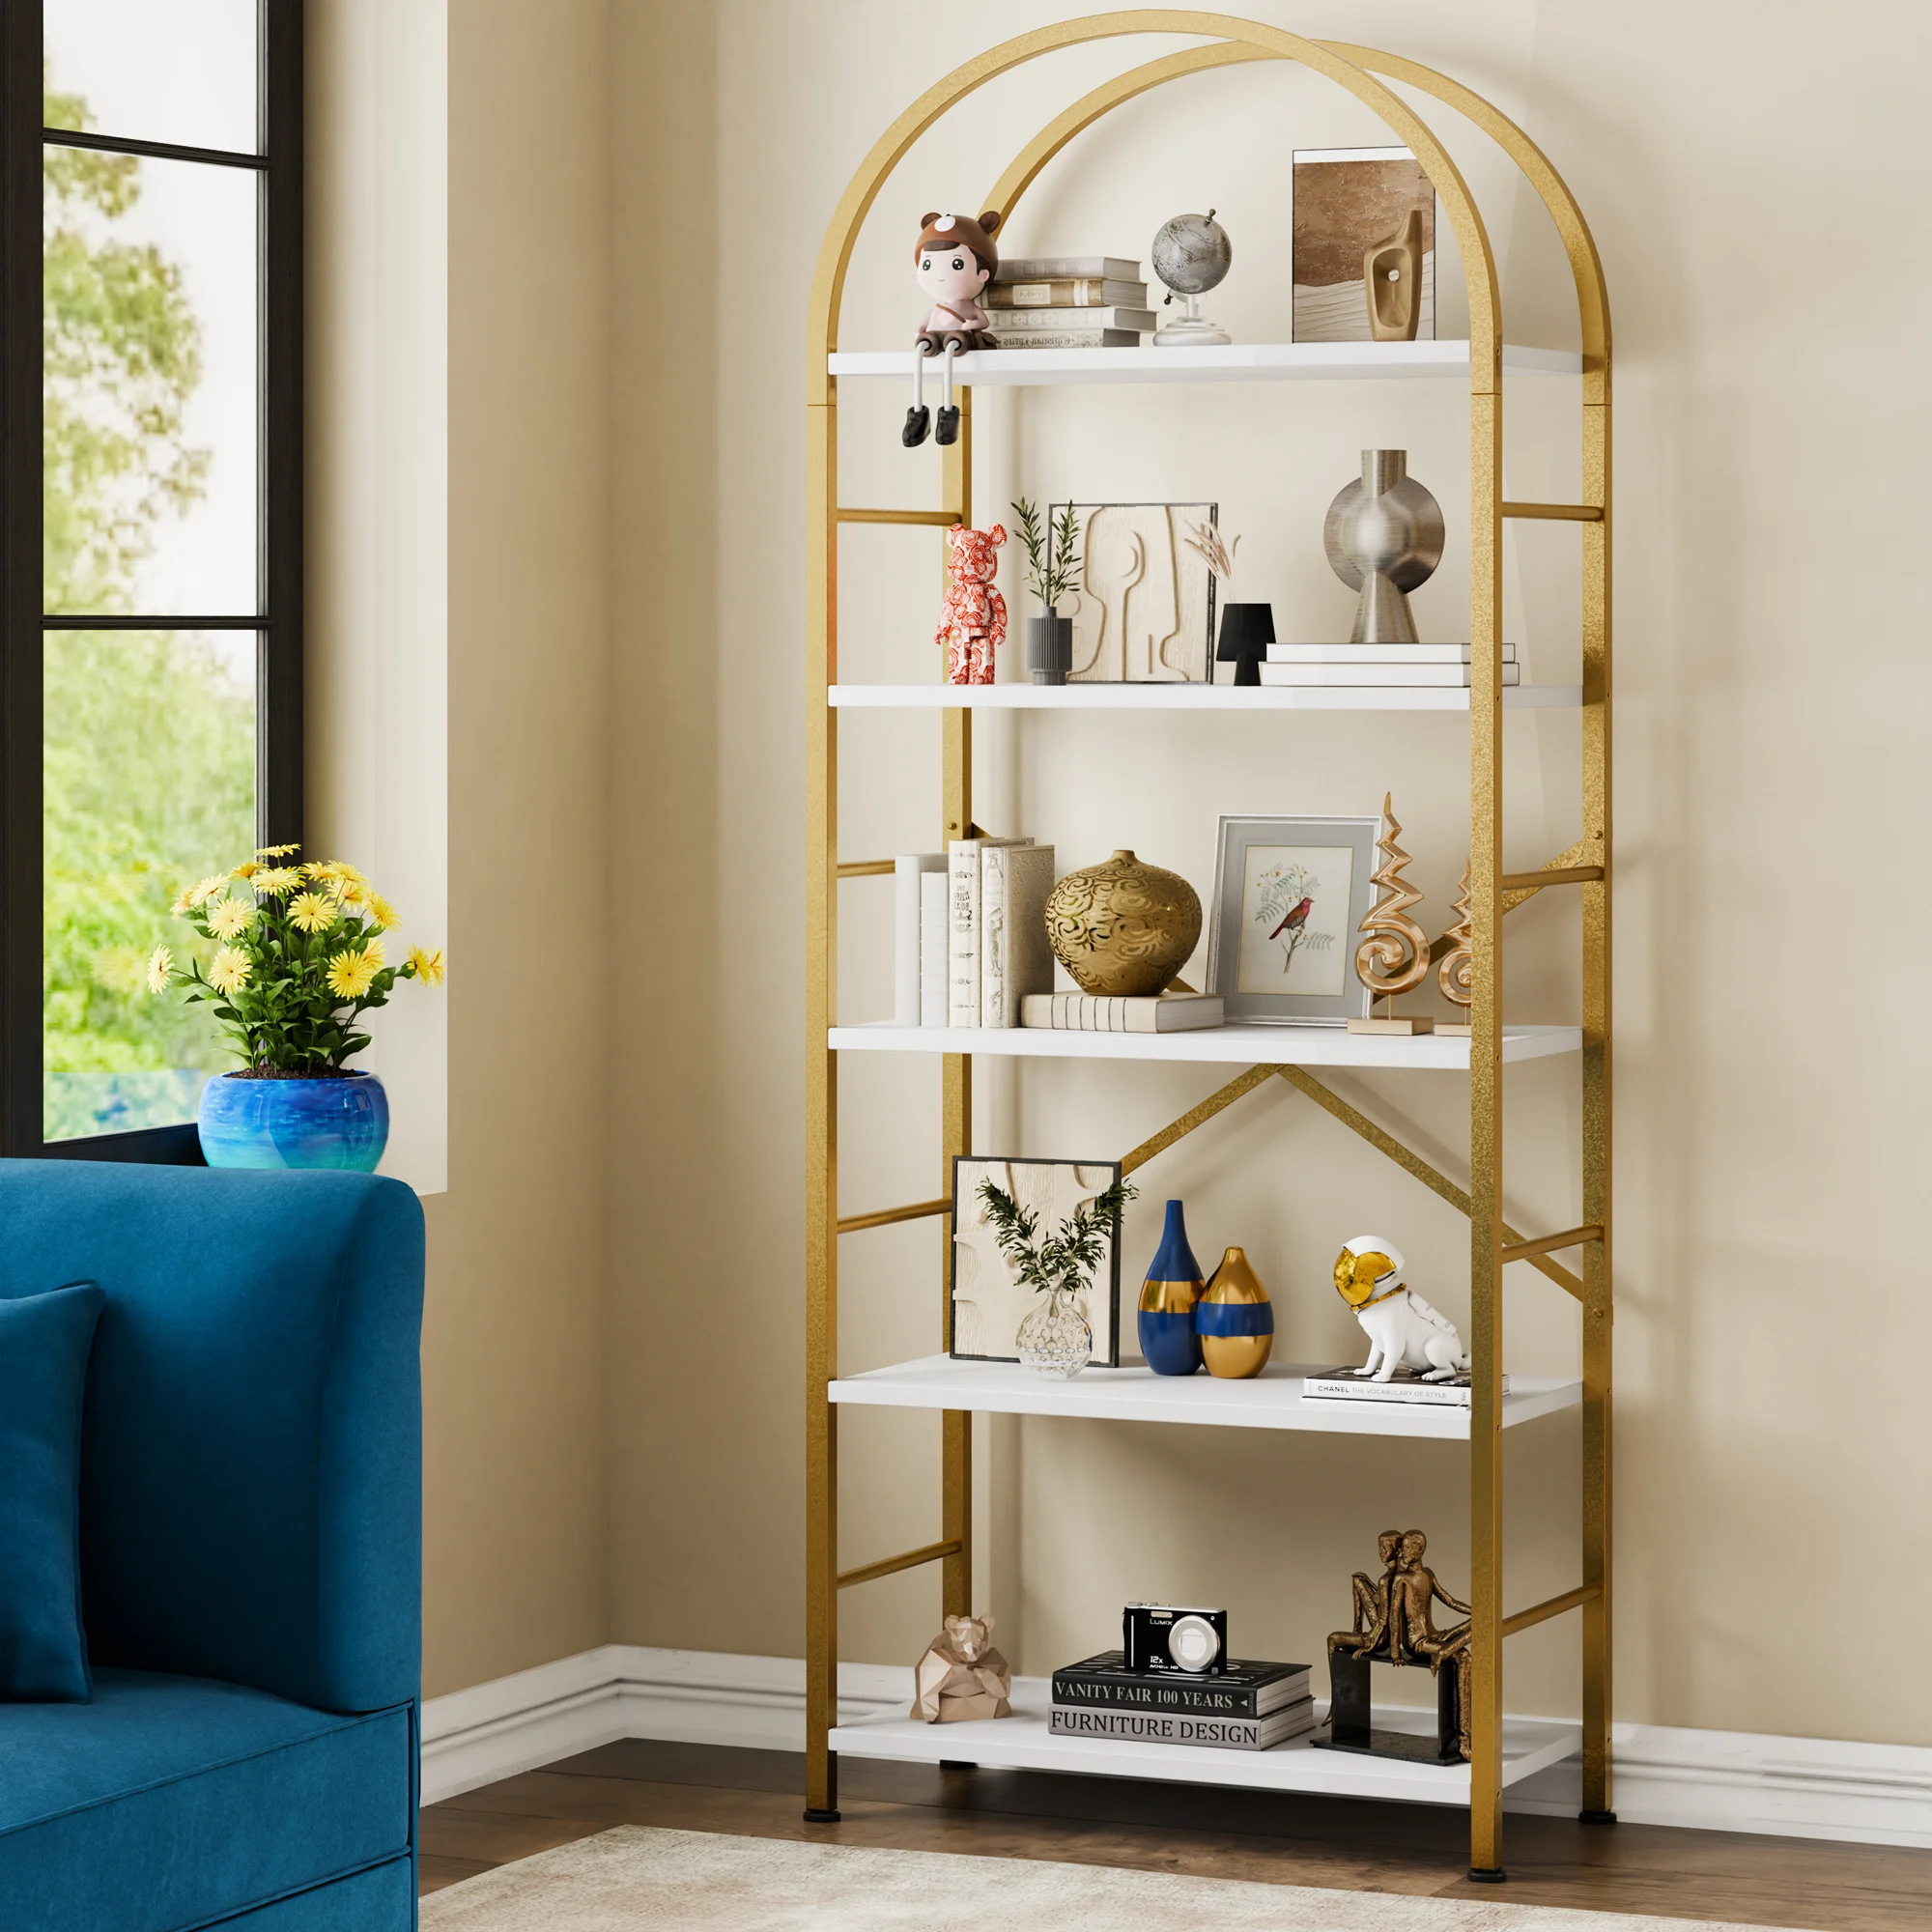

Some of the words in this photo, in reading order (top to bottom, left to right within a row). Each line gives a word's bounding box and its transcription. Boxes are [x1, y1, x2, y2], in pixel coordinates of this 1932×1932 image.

[1367, 1388, 1413, 1398] VOCABULARY
[1150, 1656, 1164, 1664] 12x
[1056, 1682, 1112, 1699] VANITY
[1116, 1686, 1152, 1703] FAIR
[1156, 1690, 1179, 1705] 100
[1183, 1692, 1233, 1708] YEARS
[1051, 1711, 1173, 1737] FURNITURE
[1180, 1722, 1257, 1744] DESIGN
